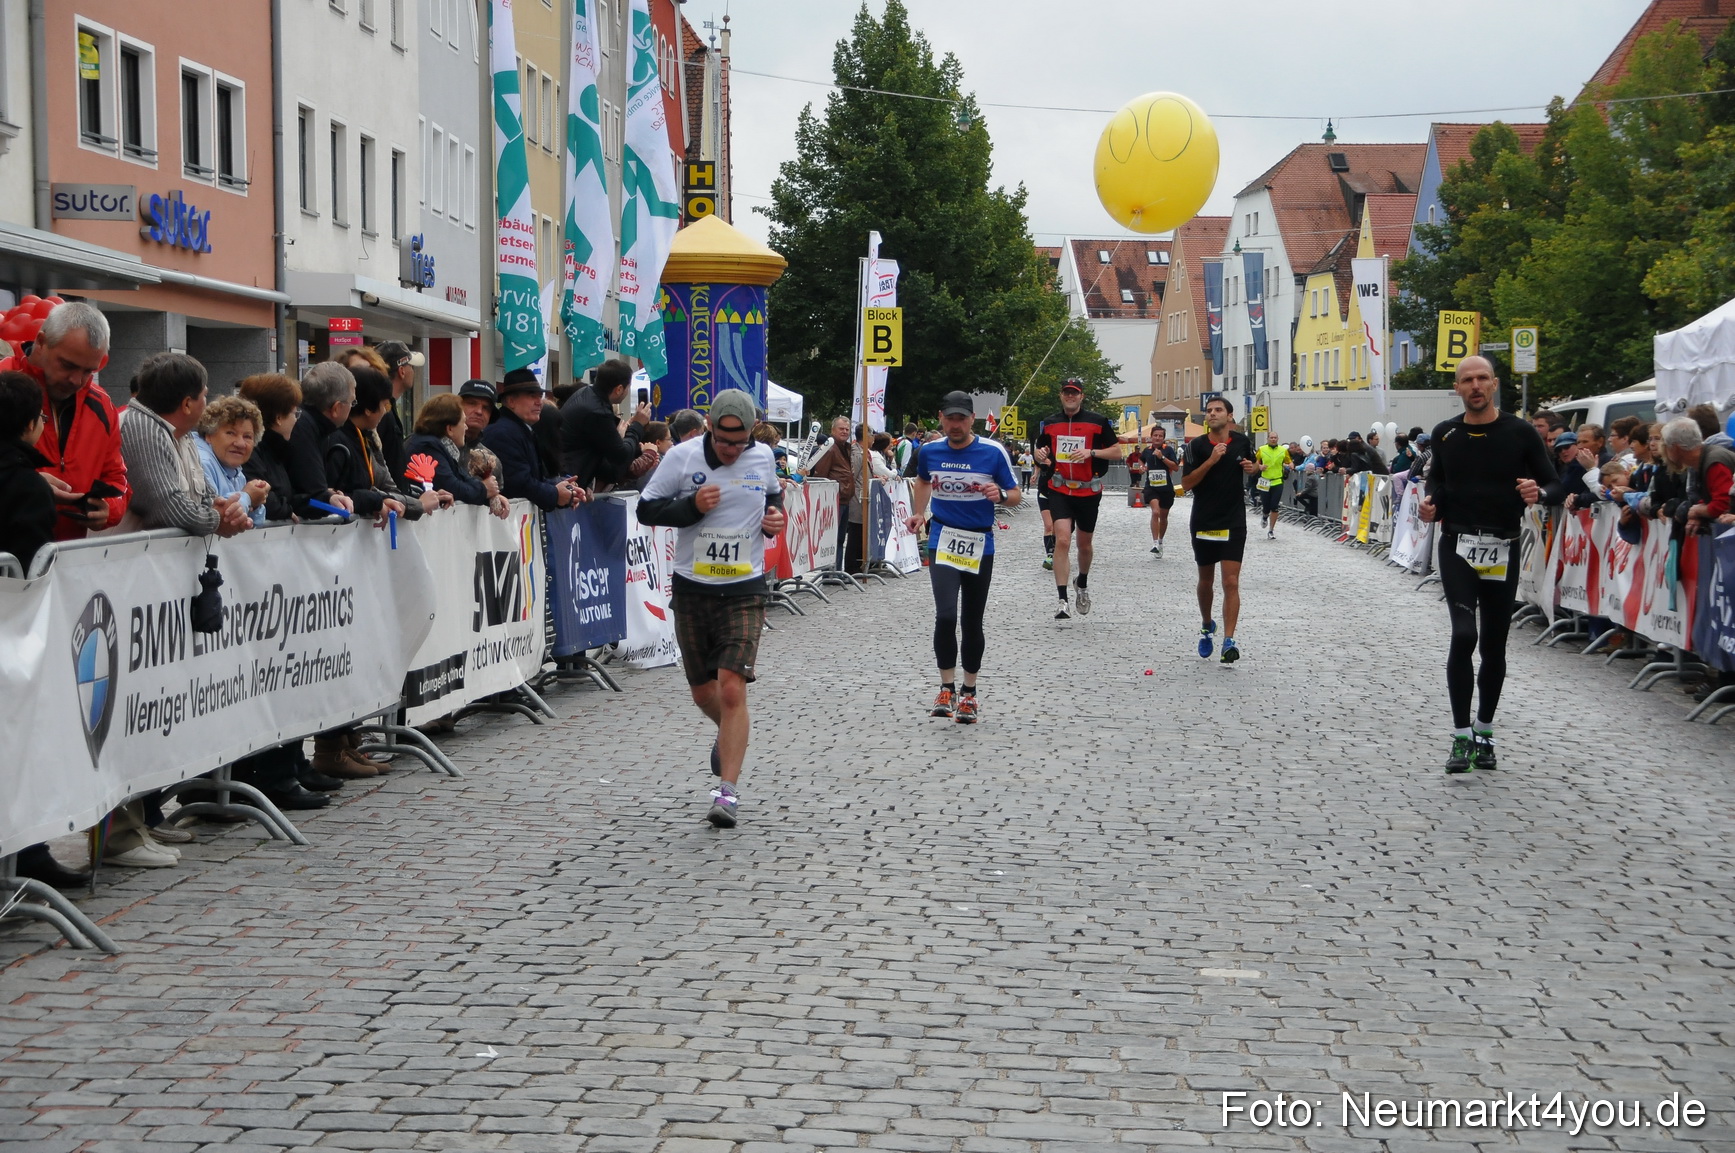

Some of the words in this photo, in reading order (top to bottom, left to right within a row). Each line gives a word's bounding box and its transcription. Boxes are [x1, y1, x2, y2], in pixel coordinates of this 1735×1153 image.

[150, 190, 212, 254] sutor
[867, 309, 898, 320] Block
[1443, 313, 1475, 325] Block
[873, 325, 892, 353] B
[1447, 330, 1467, 358] B
[1004, 414, 1013, 427] C
[1255, 414, 1265, 427] C
[1016, 426, 1024, 436] D
[706, 542, 739, 562] 441
[947, 539, 975, 556] 464
[947, 555, 971, 566] Matthias
[1467, 548, 1498, 563] 474
[710, 566, 736, 575] Robert
[129, 598, 185, 673] BMW
[125, 687, 187, 737] Weniger
[190, 664, 247, 718] Verbrauch.
[250, 657, 282, 697] Mehr
[283, 643, 353, 690] Fahrfreude.
